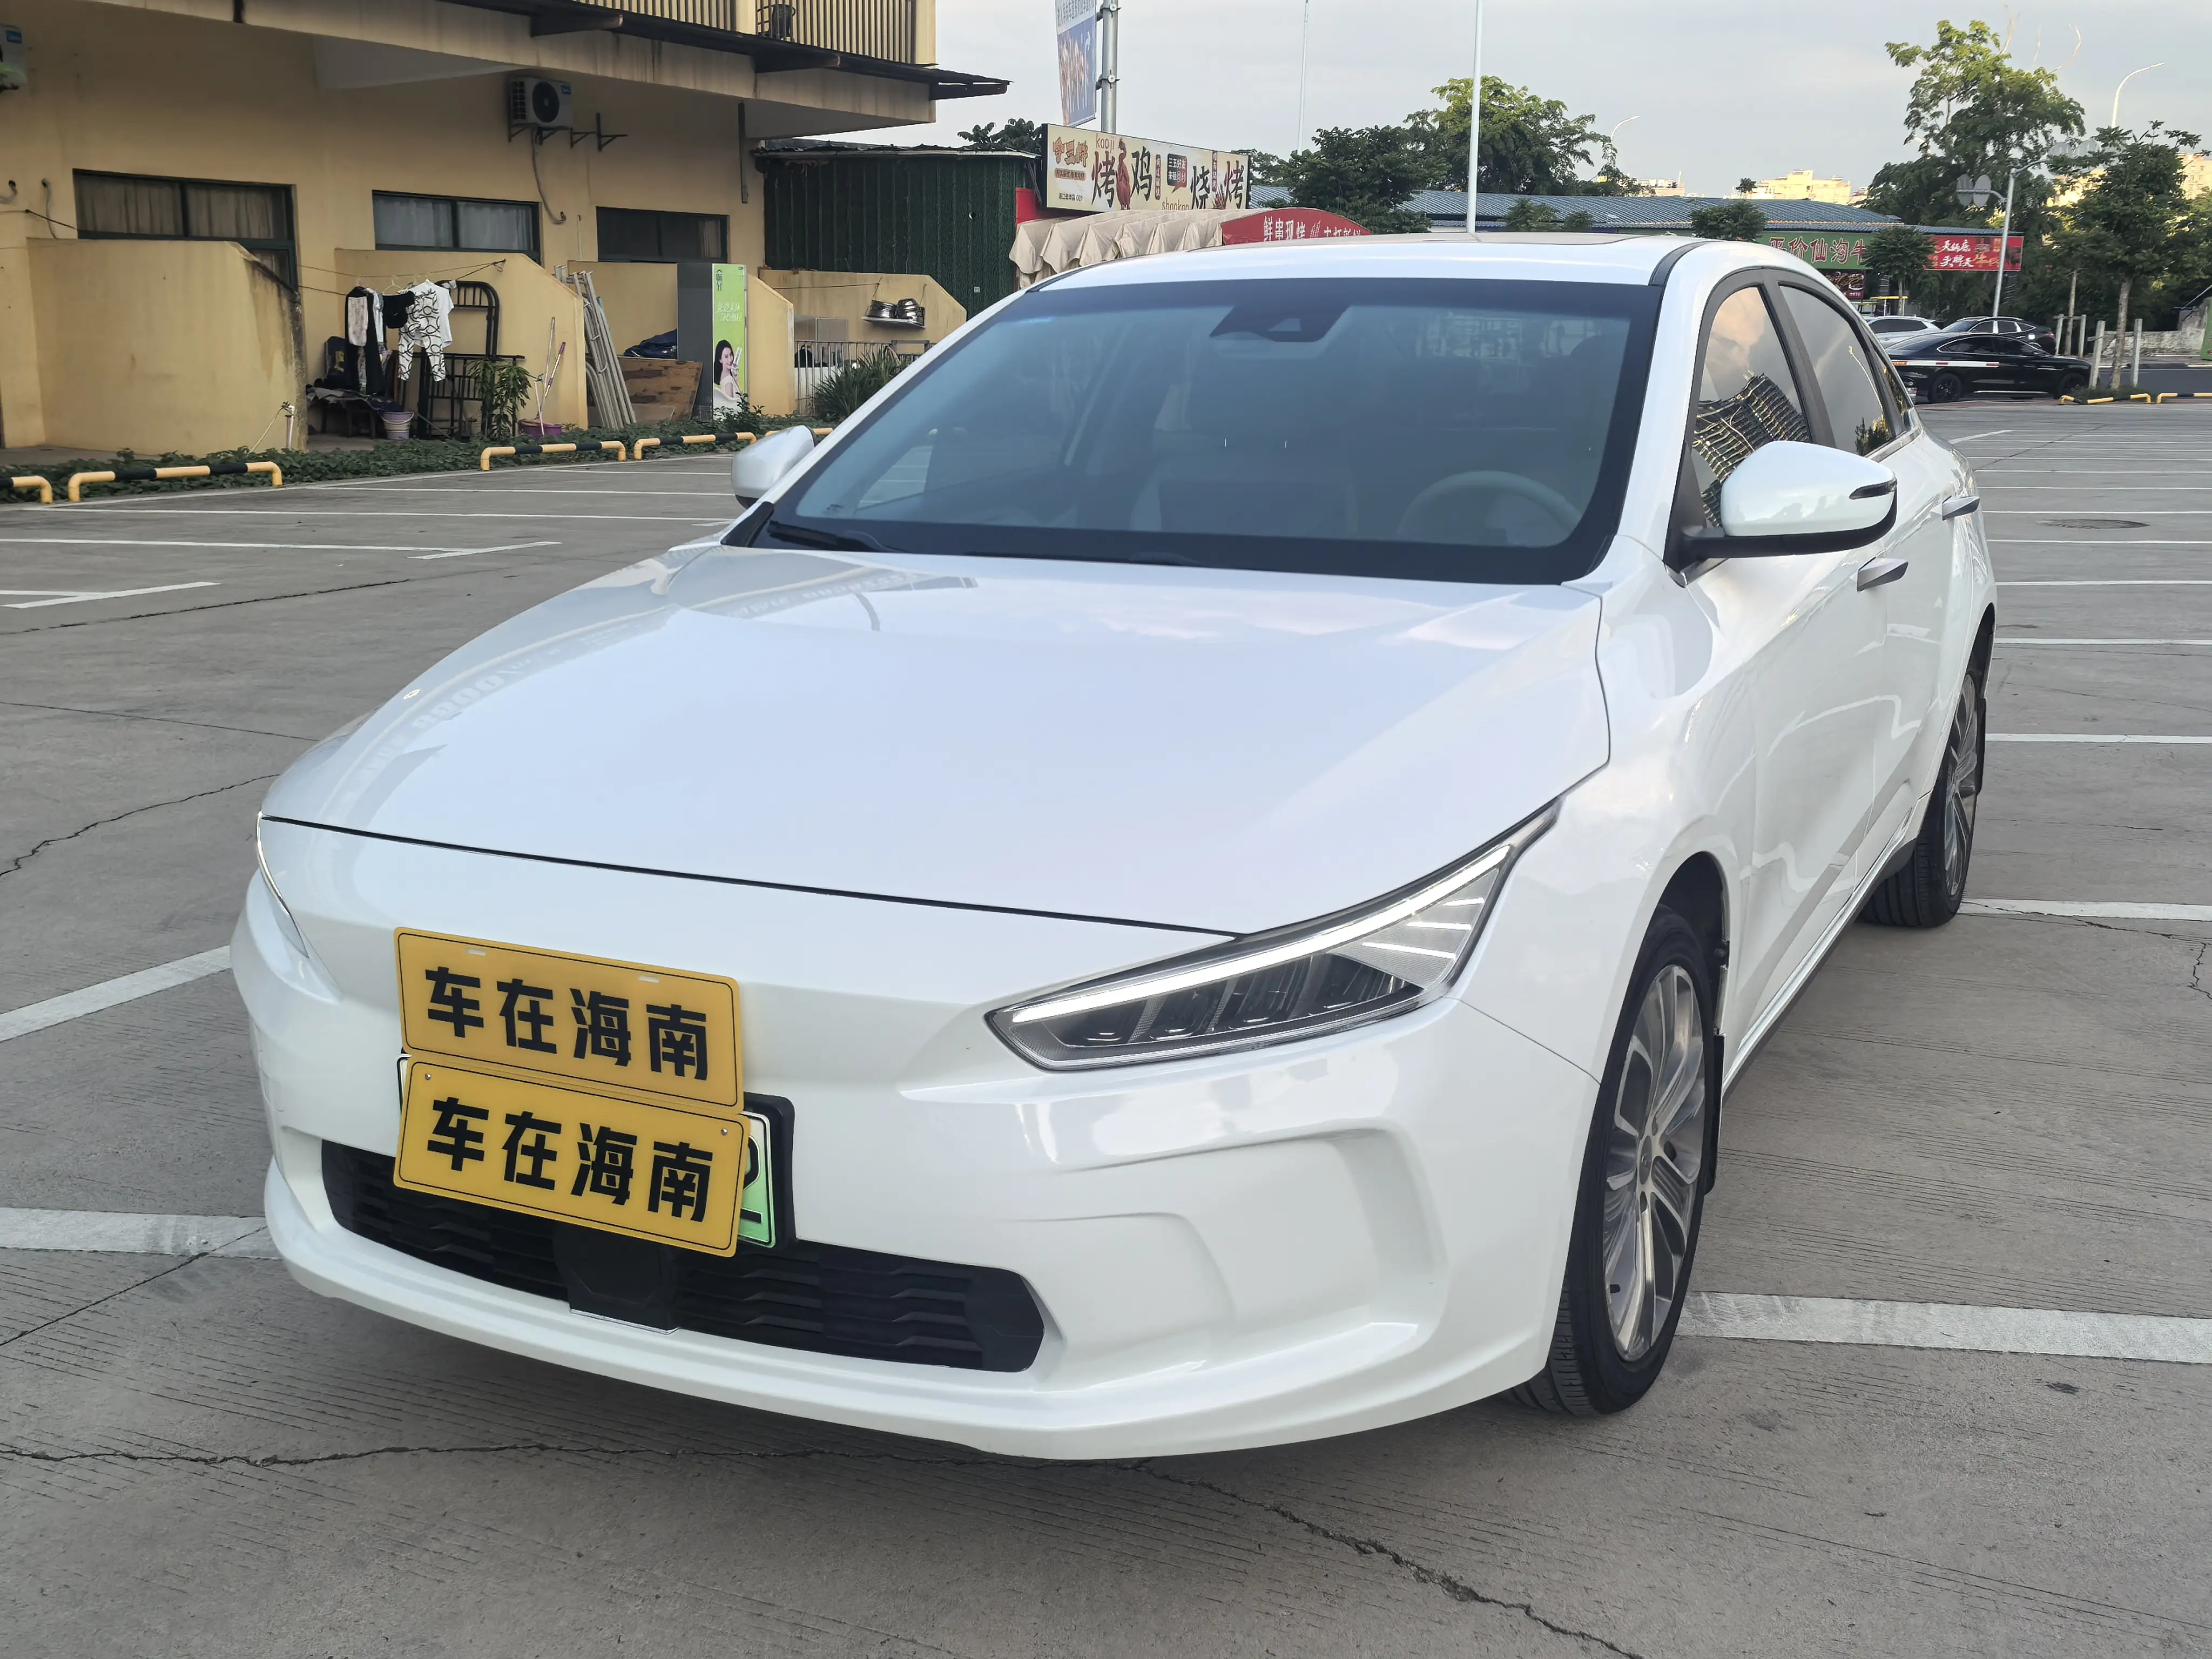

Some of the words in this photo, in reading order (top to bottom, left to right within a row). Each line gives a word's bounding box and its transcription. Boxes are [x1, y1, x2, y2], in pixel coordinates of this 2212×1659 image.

[1096, 133, 1115, 153] kaoji
[1263, 215, 1306, 242] 鲜串现烤
[425, 966, 707, 1081] 车在海南
[427, 1097, 713, 1223] 车在海南
